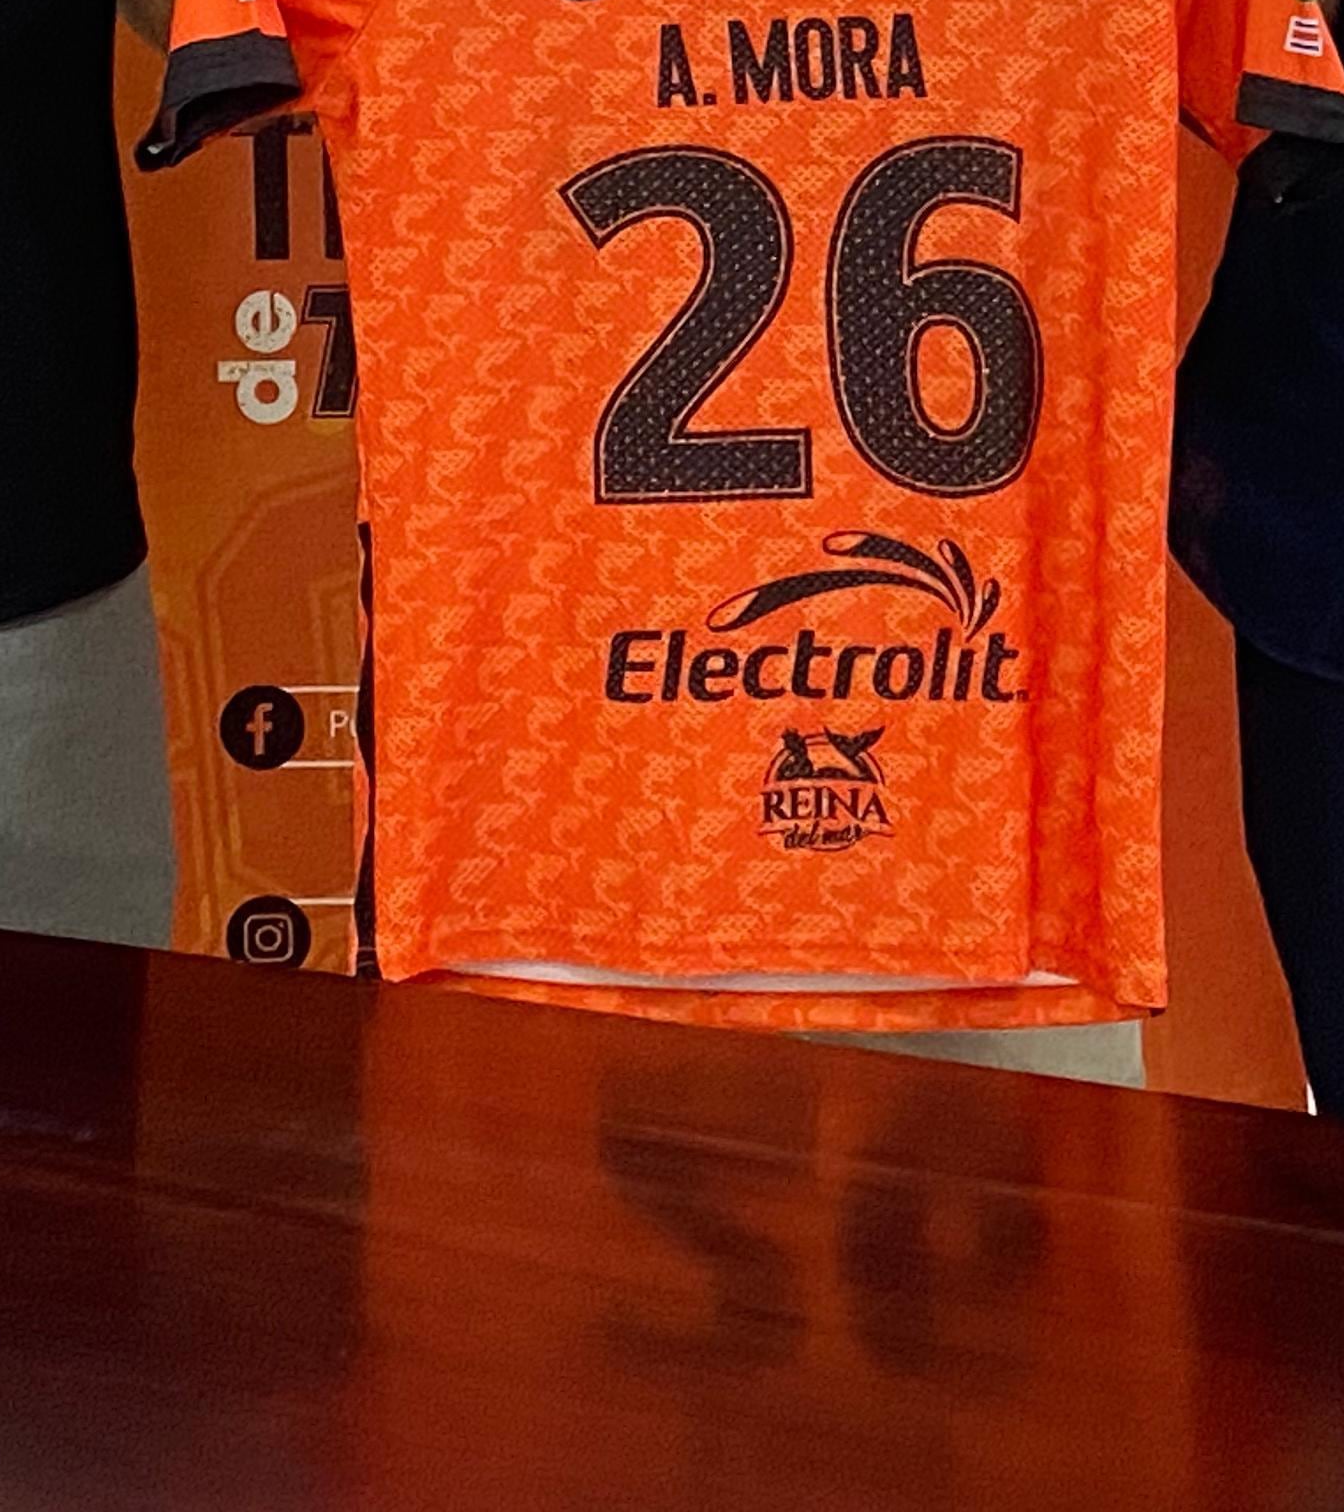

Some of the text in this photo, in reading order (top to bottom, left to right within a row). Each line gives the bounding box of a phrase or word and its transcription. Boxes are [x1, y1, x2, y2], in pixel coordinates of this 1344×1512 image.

[727, 13, 928, 106] MORA
[558, 134, 1045, 504] 26
[604, 627, 1020, 703] Electrolit
[760, 786, 893, 824] REINA
[784, 819, 820, 850] del
